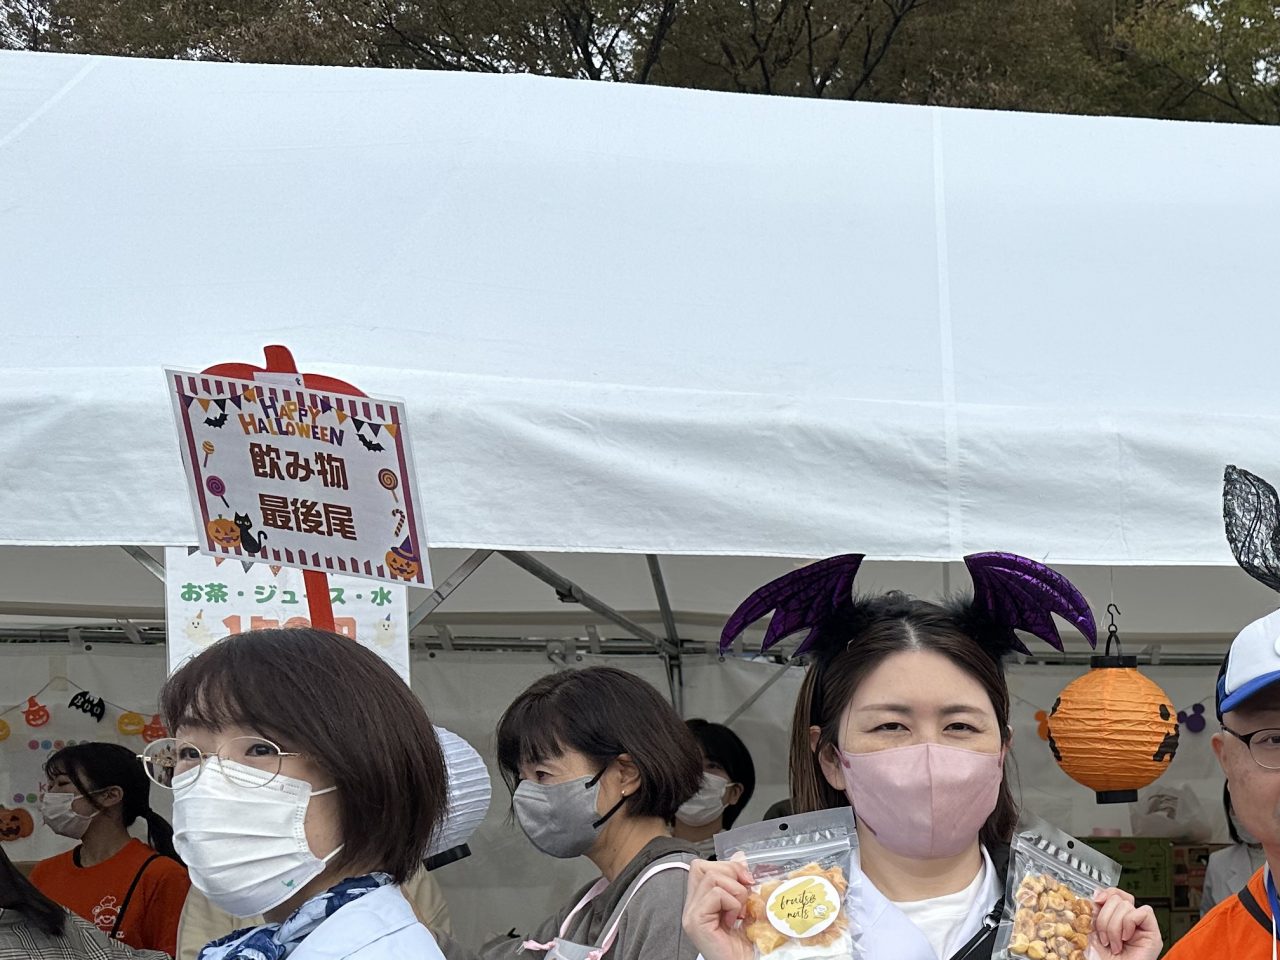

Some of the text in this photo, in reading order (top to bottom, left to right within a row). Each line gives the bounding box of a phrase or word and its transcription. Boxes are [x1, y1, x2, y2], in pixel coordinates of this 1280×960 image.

[260, 396, 320, 423] HAPPY
[237, 413, 344, 447] HALLOWEEN
[250, 442, 349, 490] 飲み物
[259, 493, 357, 541] 最後尾
[74, 695, 101, 714] BOO
[787, 906, 809, 920] nuts
